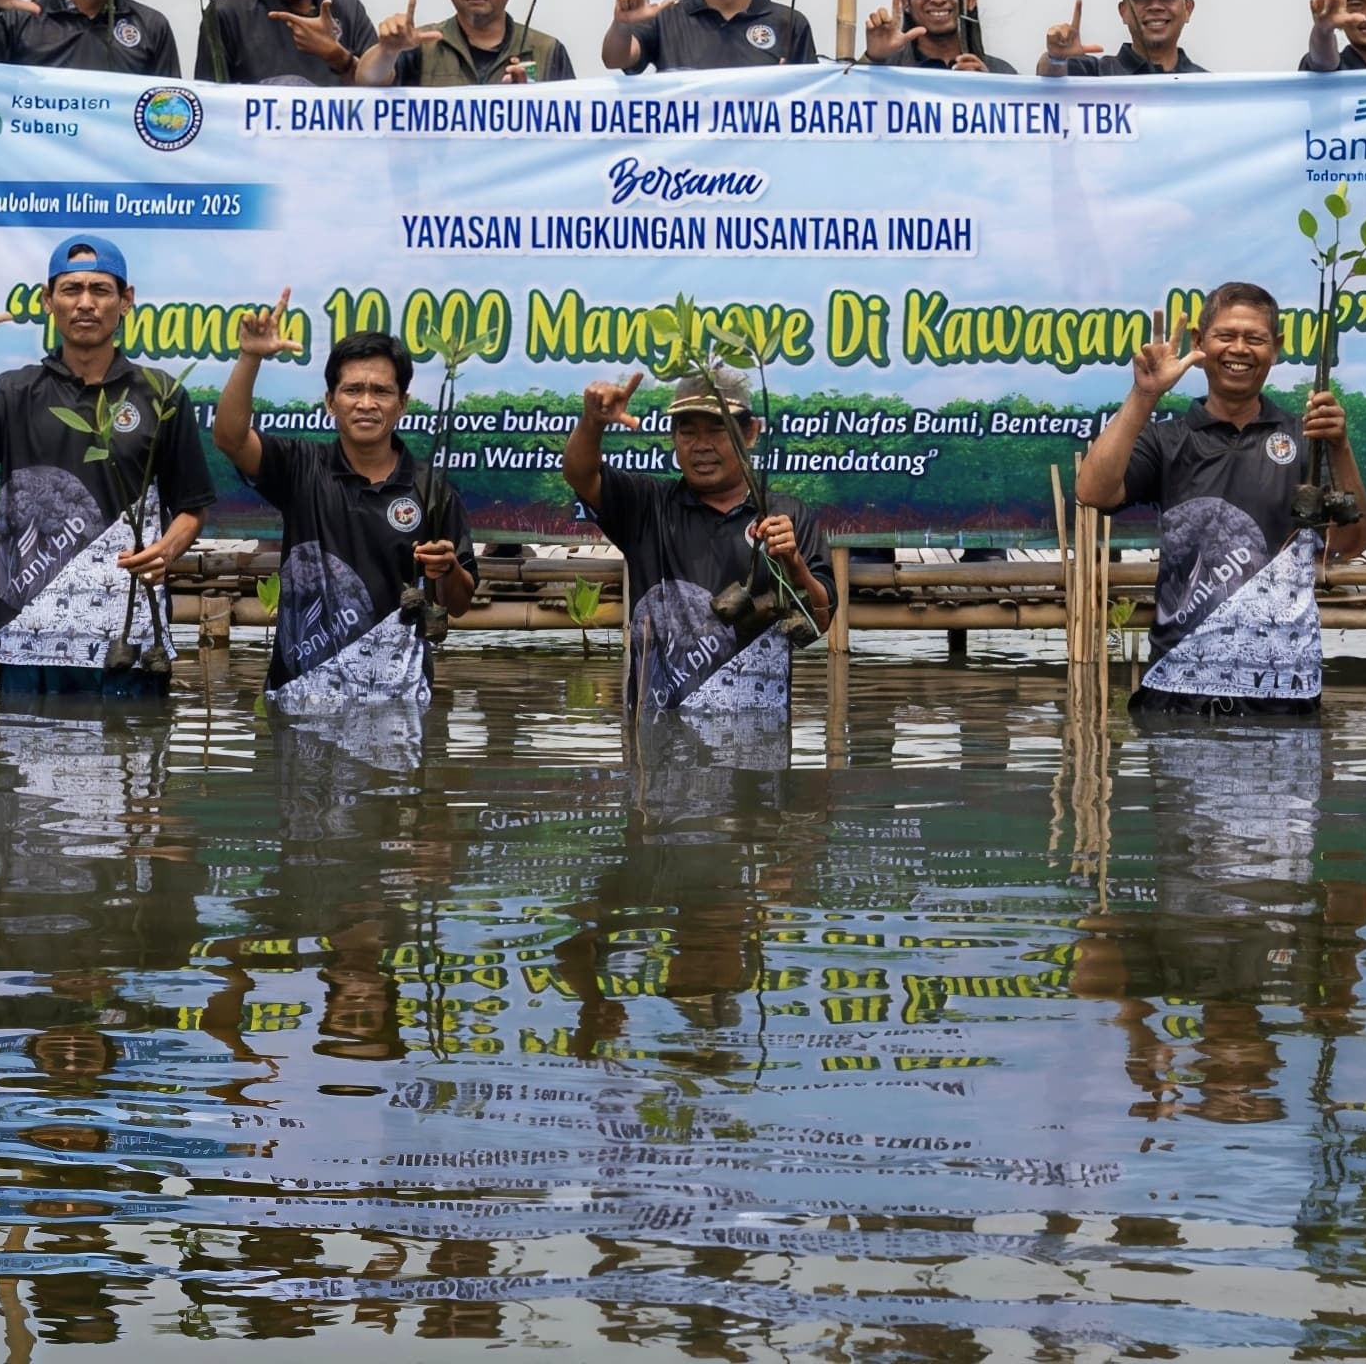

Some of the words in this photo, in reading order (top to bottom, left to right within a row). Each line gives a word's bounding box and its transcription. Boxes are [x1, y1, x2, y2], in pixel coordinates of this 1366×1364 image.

[245, 99, 281, 131] PT.
[291, 99, 364, 132] BANK
[373, 99, 582, 133] PEMBANGUNAN
[591, 100, 700, 134] DAERAH
[707, 100, 781, 134] JAWA
[790, 100, 878, 134] BARAT
[887, 101, 942, 134] DAN
[952, 102, 1069, 139] BANTEN,
[1082, 103, 1133, 135] TBK
[608, 156, 763, 205] Bersama
[201, 194, 241, 215] 2025
[402, 215, 521, 250] YAYASAN
[531, 216, 706, 250] LINGKUNGAN
[716, 216, 879, 251] NUSANTARA
[887, 217, 972, 252] INDAH
[833, 291, 882, 361] Di
[906, 291, 1145, 366] Kawasan
[781, 410, 830, 437] tapi
[835, 411, 907, 436] Nafas
[990, 412, 1093, 438] Benteng
